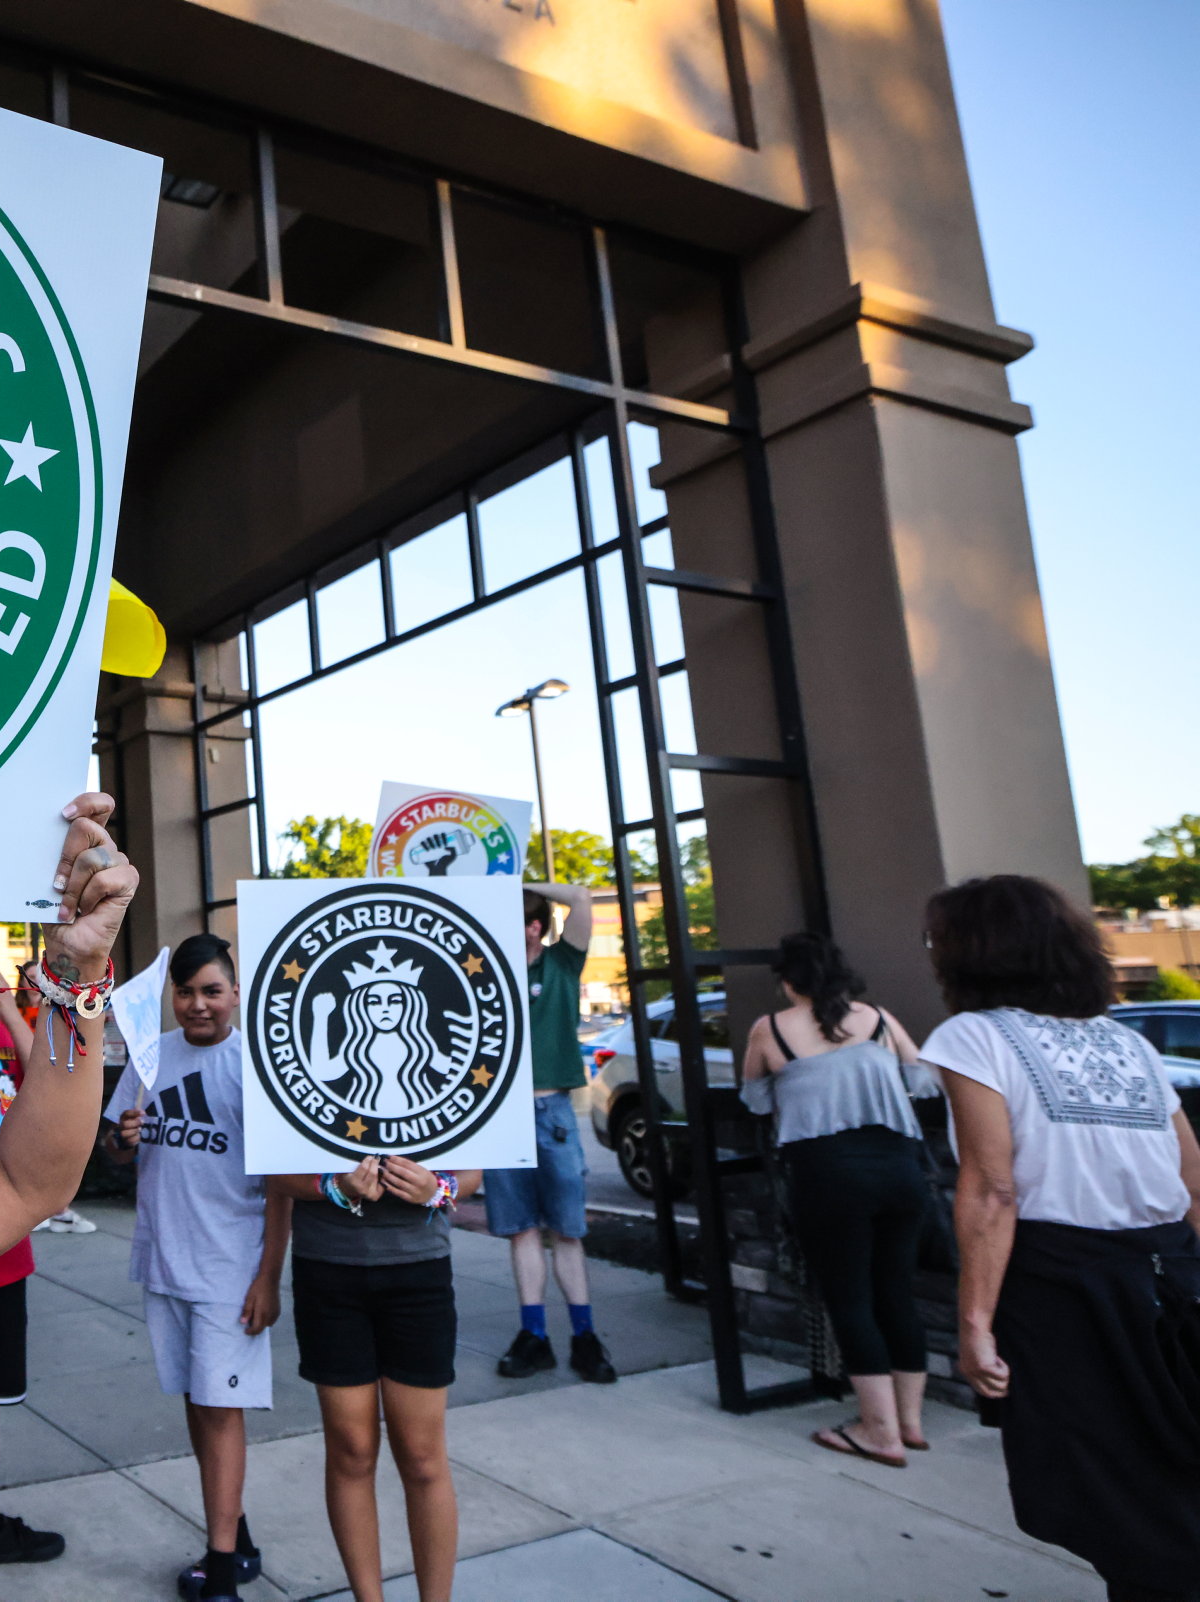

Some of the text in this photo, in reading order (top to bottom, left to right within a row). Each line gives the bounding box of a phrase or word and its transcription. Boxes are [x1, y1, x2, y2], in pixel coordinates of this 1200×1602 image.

[401, 802, 504, 848] STARBUCKS
[301, 905, 467, 956] STARBUCKS
[269, 991, 340, 1125] WORKERS
[379, 1089, 475, 1143] UNITED
[140, 1116, 229, 1155] adidas
